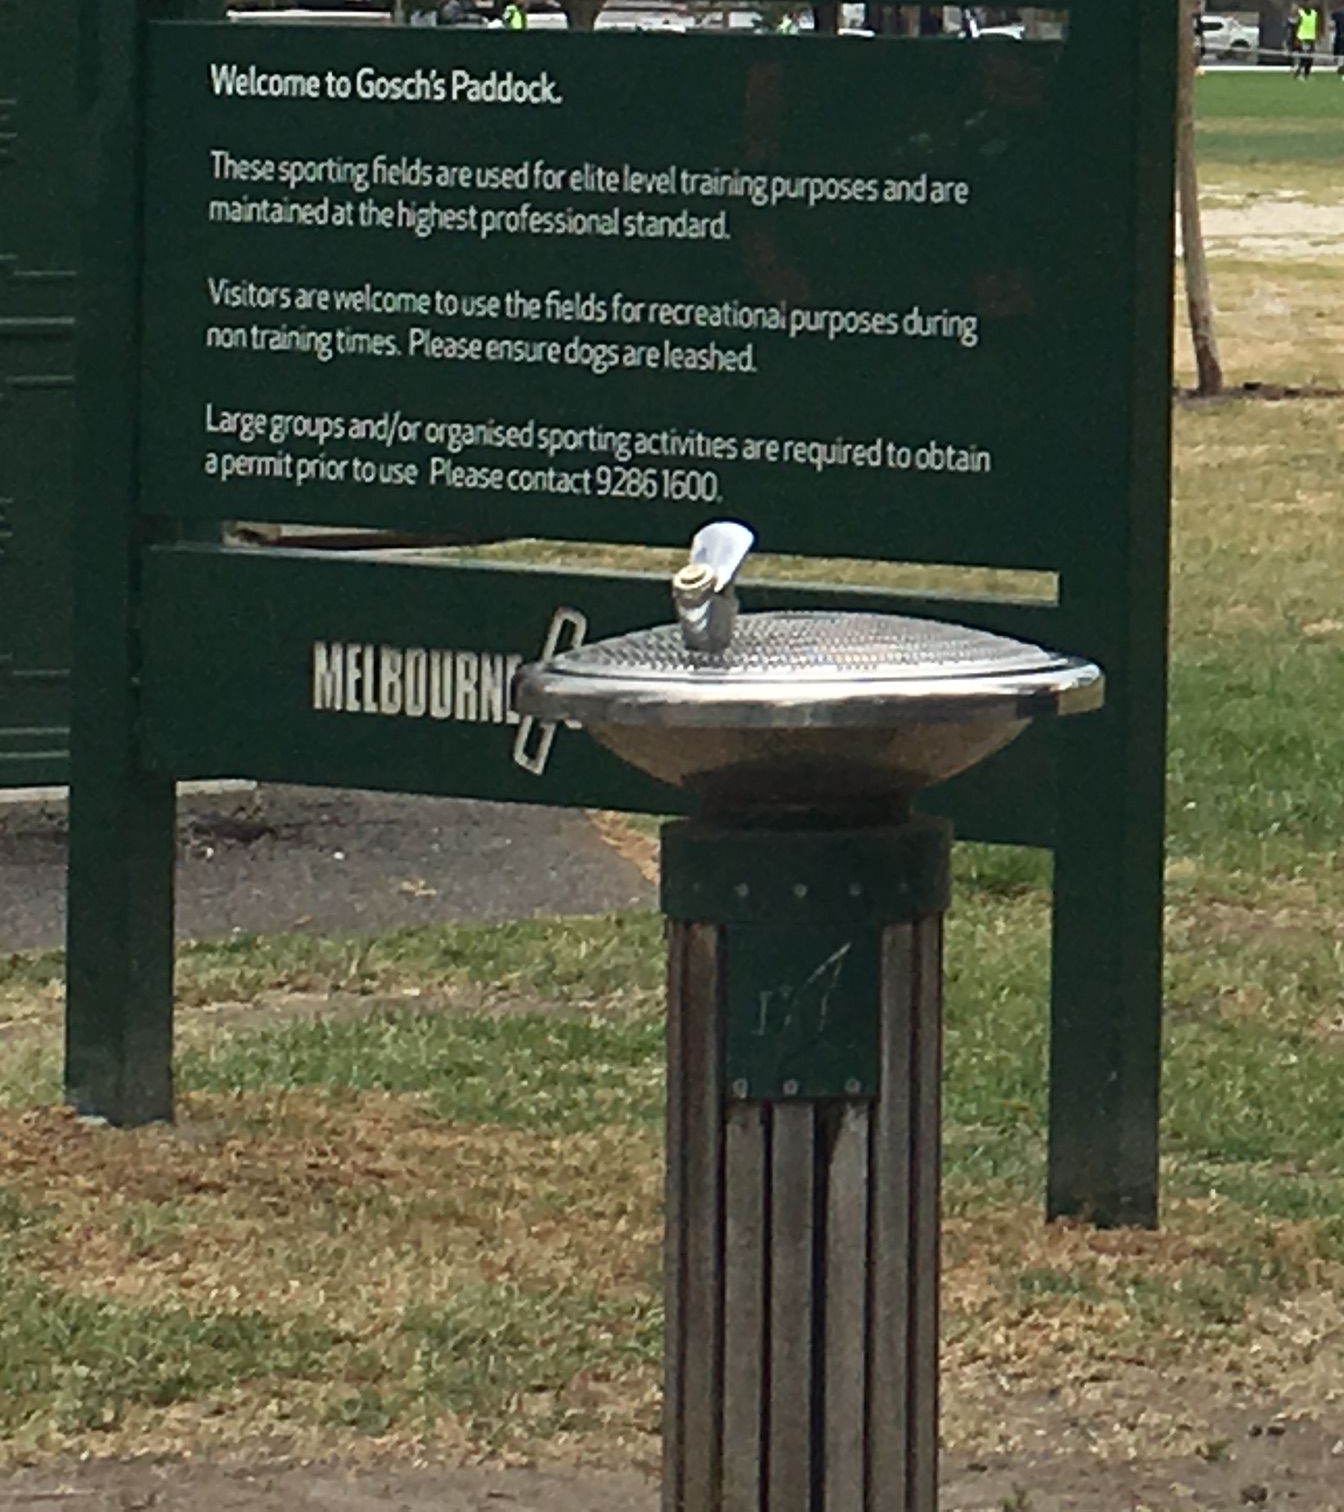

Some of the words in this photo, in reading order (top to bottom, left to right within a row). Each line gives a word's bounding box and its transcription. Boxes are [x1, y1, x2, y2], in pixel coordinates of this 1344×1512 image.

[210, 63, 320, 98] Welcome
[324, 70, 352, 99] to
[356, 67, 447, 101] Gosch's
[451, 69, 563, 104] Paddock.
[210, 149, 275, 181] These
[277, 157, 370, 193] sporting
[372, 154, 433, 187] fields
[435, 165, 473, 188] are
[475, 161, 530, 190] used
[533, 159, 567, 191] for
[569, 162, 620, 193] elite
[623, 164, 676, 194] level
[680, 168, 769, 207] training
[771, 175, 879, 207] purposes
[882, 173, 927, 203] and
[930, 181, 969, 205] are
[209, 194, 329, 225] maintained
[331, 201, 354, 227] at
[358, 198, 395, 229] the
[397, 198, 478, 238] highest
[480, 202, 620, 240] professional
[623, 209, 731, 240] standard.
[207, 277, 292, 309] Visitors
[294, 287, 331, 311] are
[333, 283, 431, 315] welcome
[434, 290, 459, 317] to
[461, 295, 501, 318] use
[504, 289, 542, 320] the
[544, 289, 608, 323] fields
[611, 292, 646, 324] for
[648, 300, 786, 330] recreational
[789, 309, 899, 341] purposes
[902, 306, 978, 348] during
[206, 327, 248, 349] non
[250, 323, 333, 362] training
[335, 327, 402, 356] times.
[408, 327, 483, 360] Please
[485, 339, 562, 364] ensure
[564, 335, 620, 375] dogs
[622, 344, 661, 369] are
[663, 339, 757, 373] leashed.
[206, 403, 268, 443] Large
[269, 414, 346, 446] groups
[348, 410, 422, 448] and/or
[424, 419, 535, 454] organised
[537, 425, 632, 462] sporting
[634, 428, 738, 460] activities
[742, 438, 780, 462] are
[783, 437, 882, 472] required
[886, 442, 911, 469] to
[915, 440, 991, 472] obtain
[204, 452, 218, 474] a
[221, 450, 293, 482] permit
[296, 452, 349, 487] prior
[352, 457, 376, 483] to
[379, 463, 419, 485] use
[429, 456, 504, 490] Please
[506, 467, 592, 495] contact
